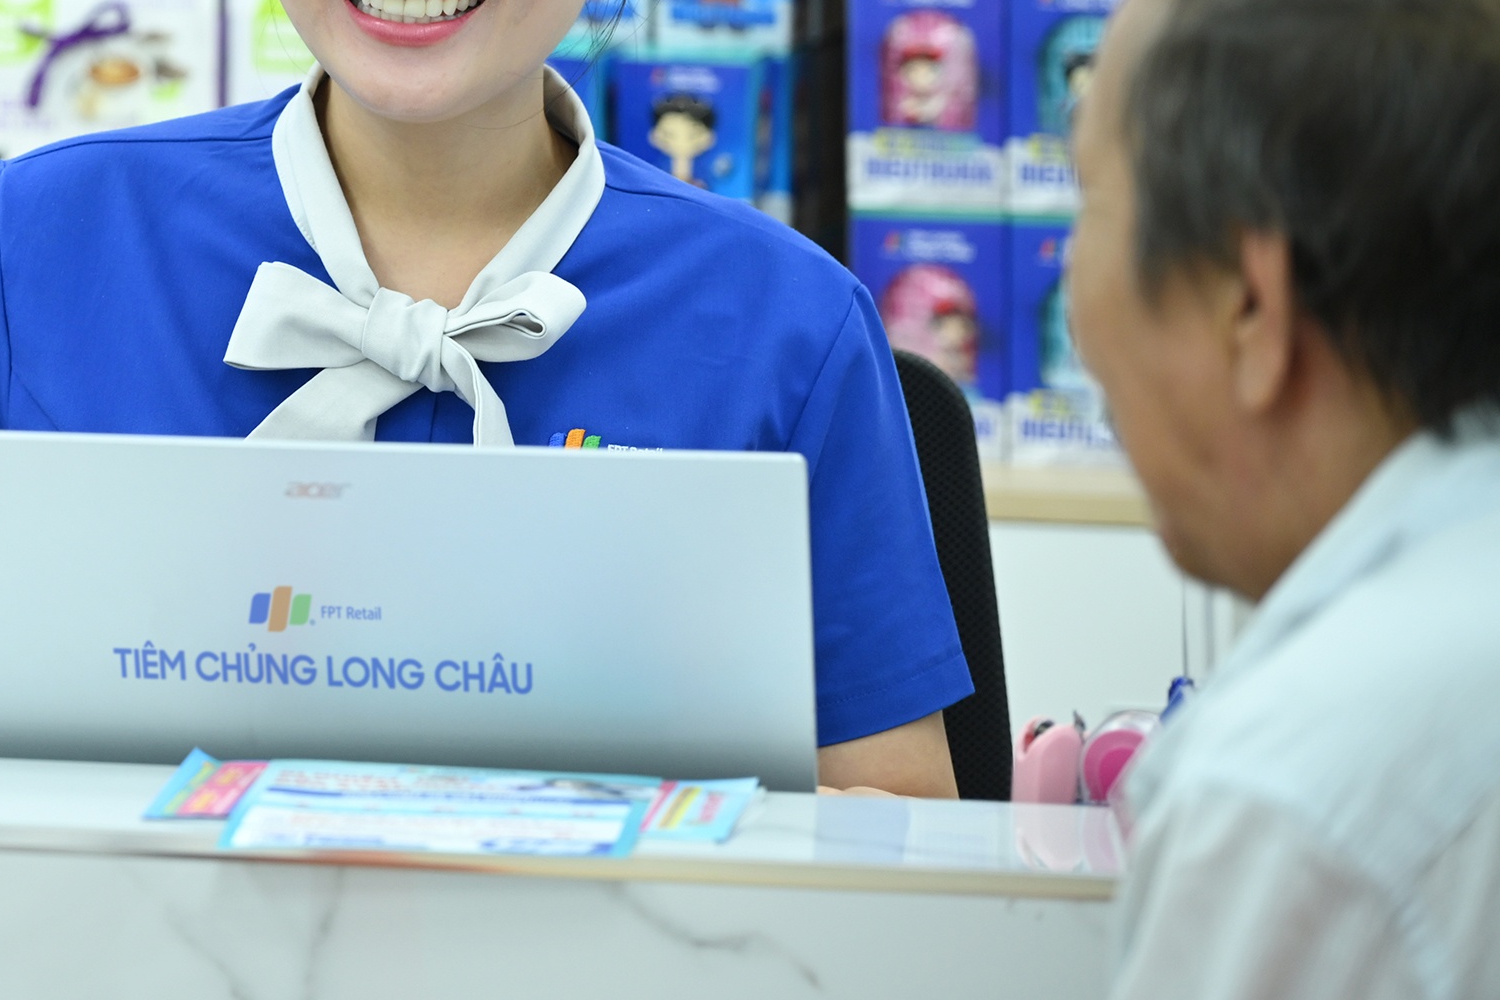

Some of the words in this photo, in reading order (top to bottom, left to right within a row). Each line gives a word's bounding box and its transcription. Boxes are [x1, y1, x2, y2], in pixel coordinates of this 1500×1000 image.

[320, 605, 342, 619] FPT
[346, 605, 382, 621] Retail
[112, 640, 187, 681] TIÊM
[195, 642, 318, 687] CHỦNG
[326, 655, 425, 691] LONG
[434, 652, 534, 695] CHÂU
